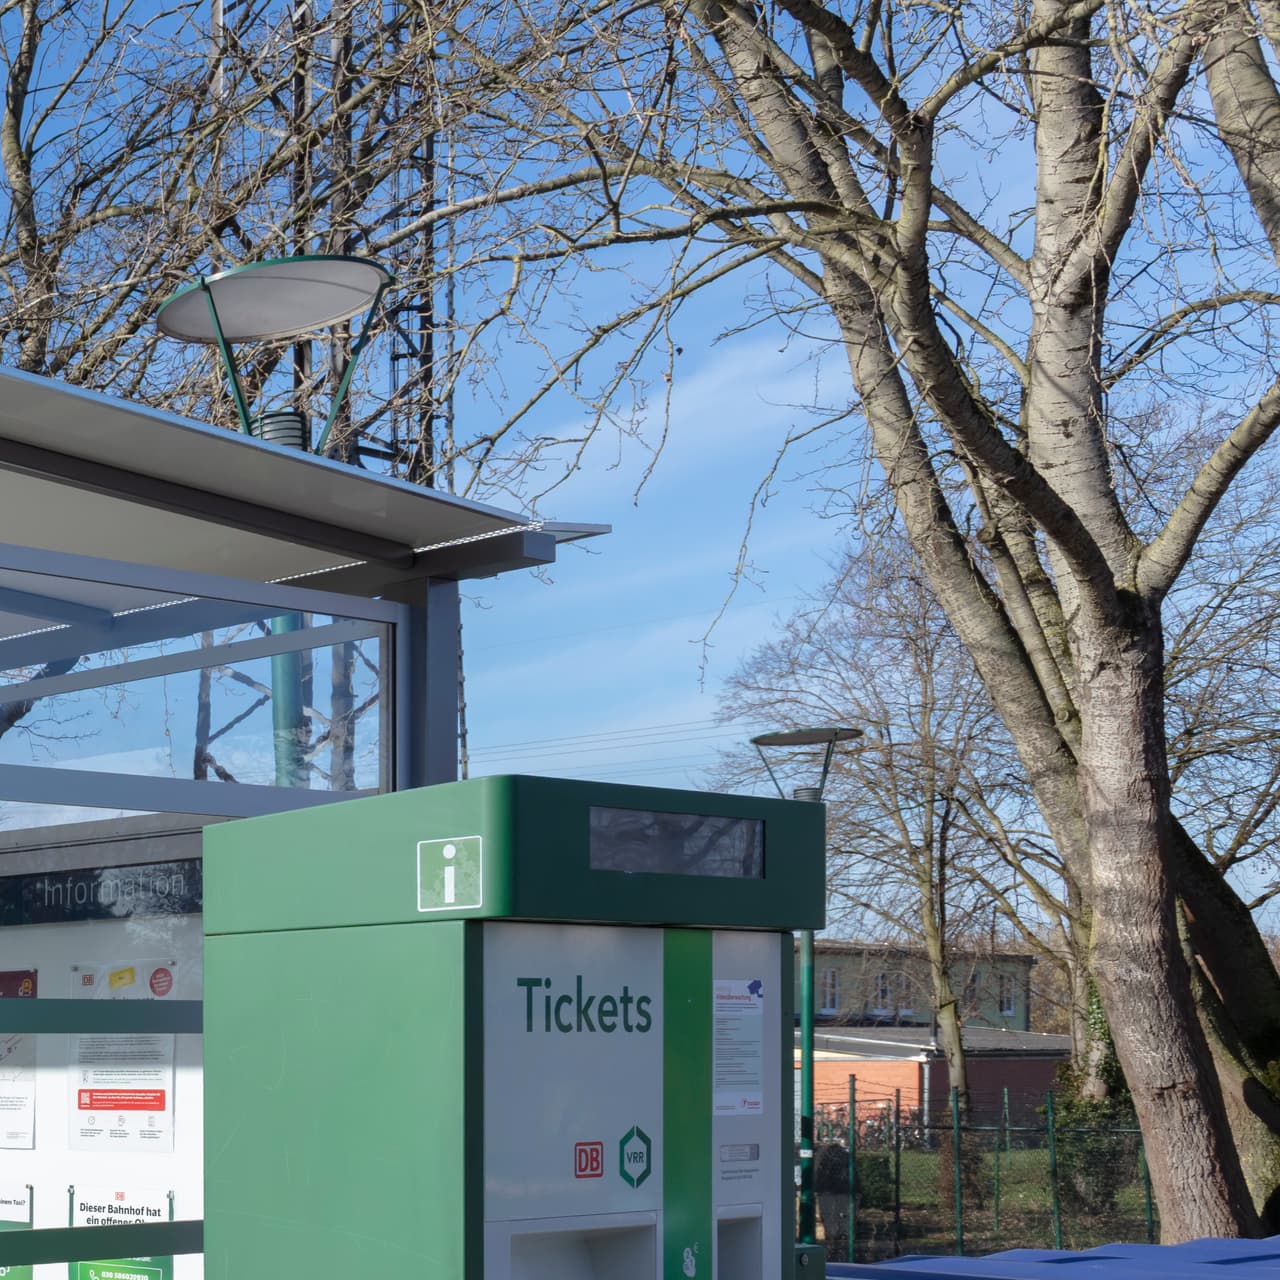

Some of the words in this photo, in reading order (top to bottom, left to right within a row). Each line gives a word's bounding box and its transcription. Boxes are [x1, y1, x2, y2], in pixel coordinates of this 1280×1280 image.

[44, 871, 185, 906] Information
[83, 975, 94, 985] DB
[517, 975, 652, 1033] Tickets
[578, 1147, 600, 1172] DB
[626, 1151, 645, 1164] VRR
[80, 1202, 106, 1213] Dieser
[108, 1204, 144, 1216] Bahnhof
[146, 1207, 161, 1217] hat
[86, 1215, 99, 1225] ein
